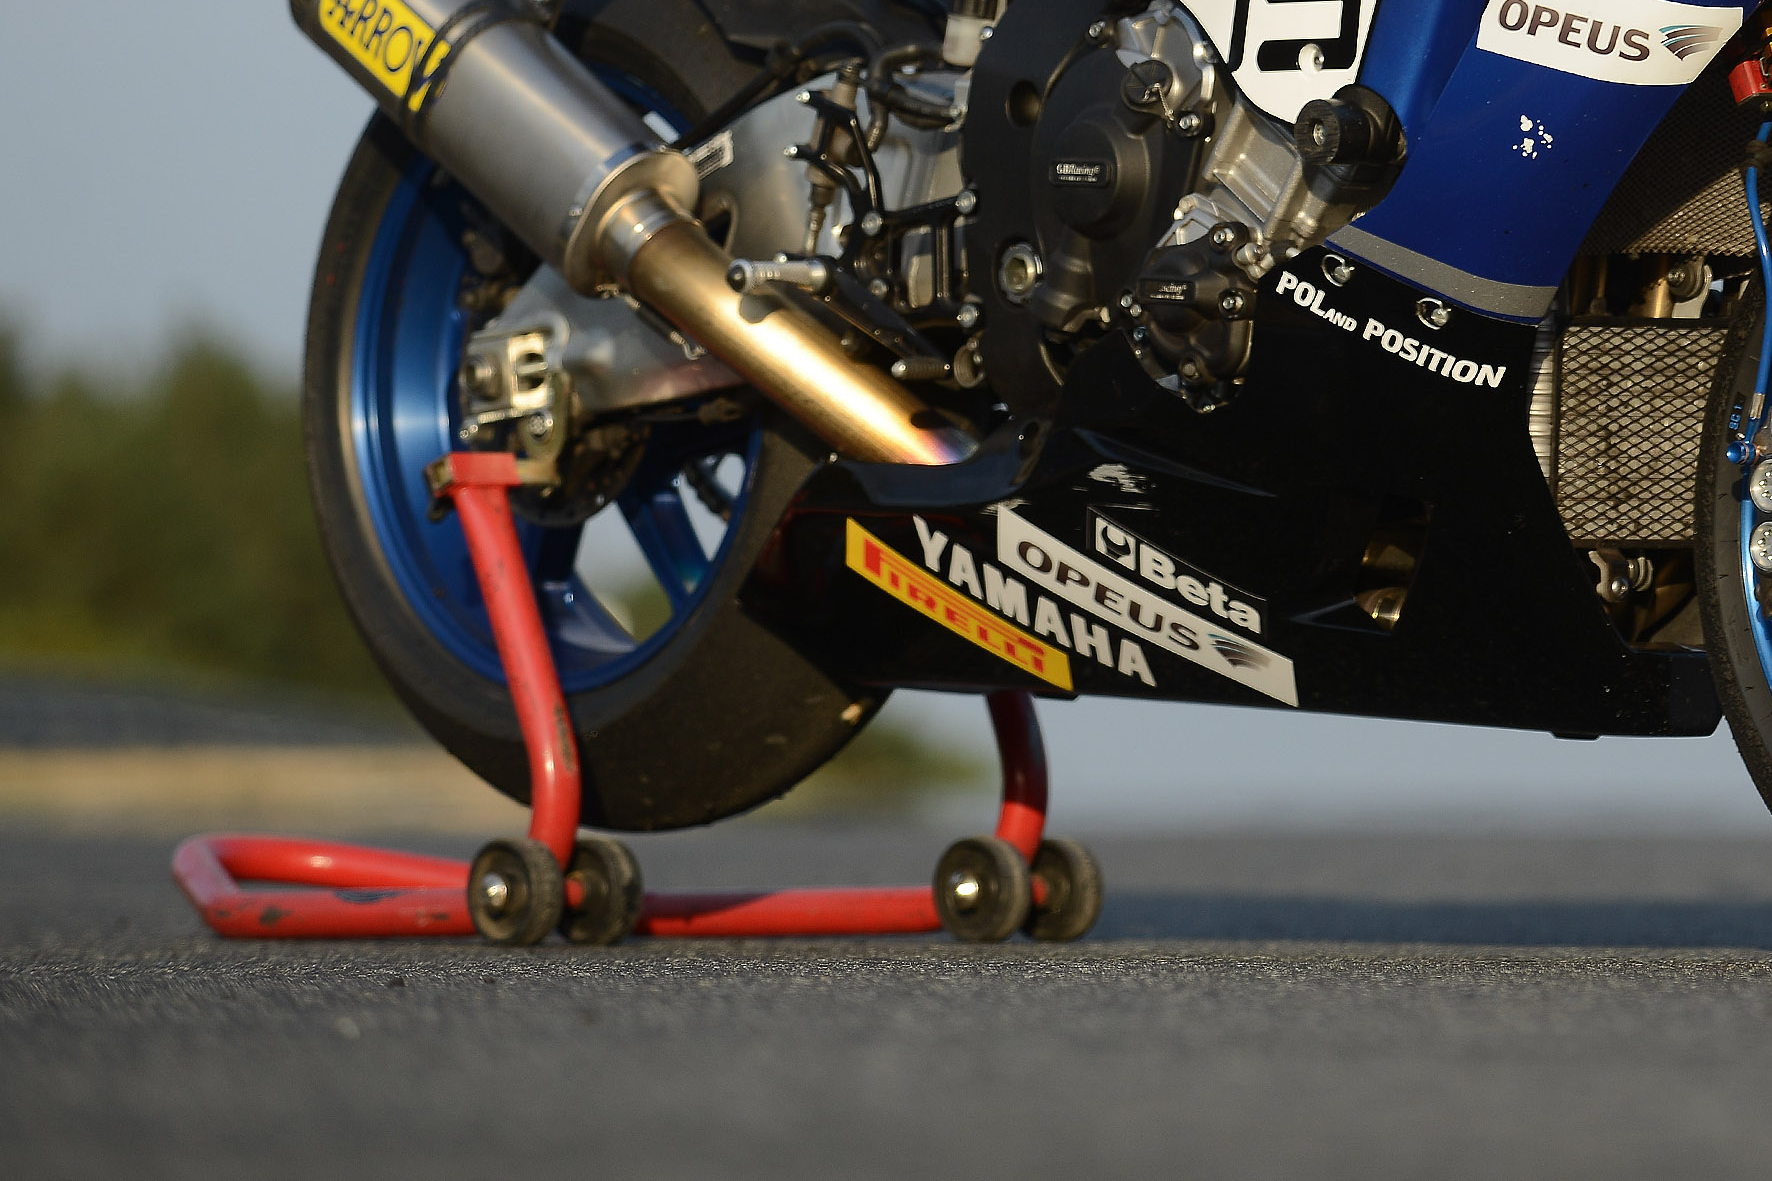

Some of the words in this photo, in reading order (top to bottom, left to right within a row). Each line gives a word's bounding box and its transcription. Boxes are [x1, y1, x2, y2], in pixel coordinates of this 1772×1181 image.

[1362, 318, 1507, 389] POSITION
[863, 538, 1045, 674] PIRELLI
[912, 515, 1157, 687] YAMAHA
[1017, 540, 1200, 652] OPEUS
[1139, 551, 1262, 634] Beta
